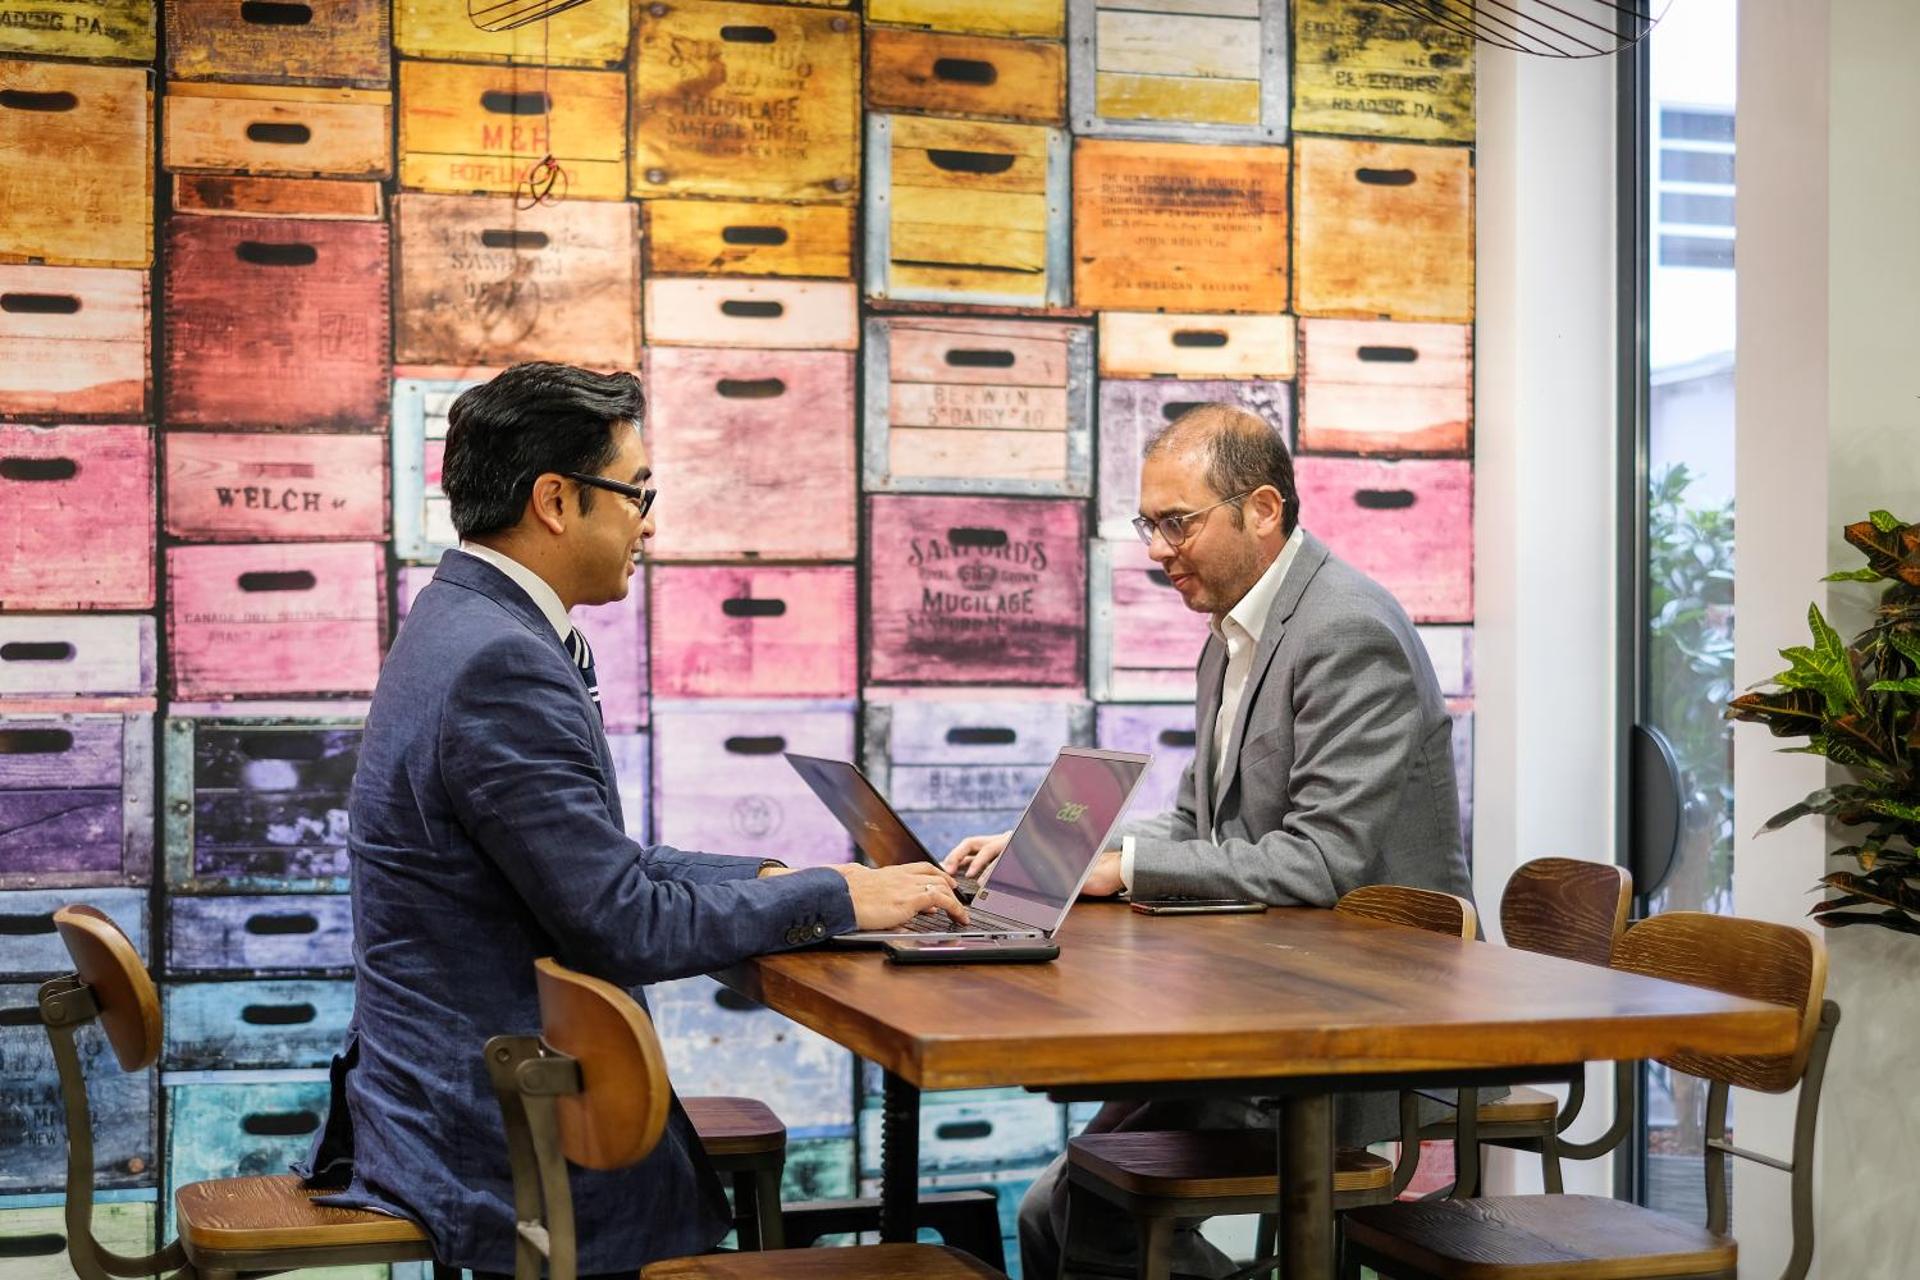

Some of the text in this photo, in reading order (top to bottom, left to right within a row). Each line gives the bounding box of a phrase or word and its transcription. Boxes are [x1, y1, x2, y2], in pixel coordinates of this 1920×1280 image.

[482, 124, 503, 149] M
[216, 486, 321, 512] WELCH
[1056, 802, 1088, 822] acer
